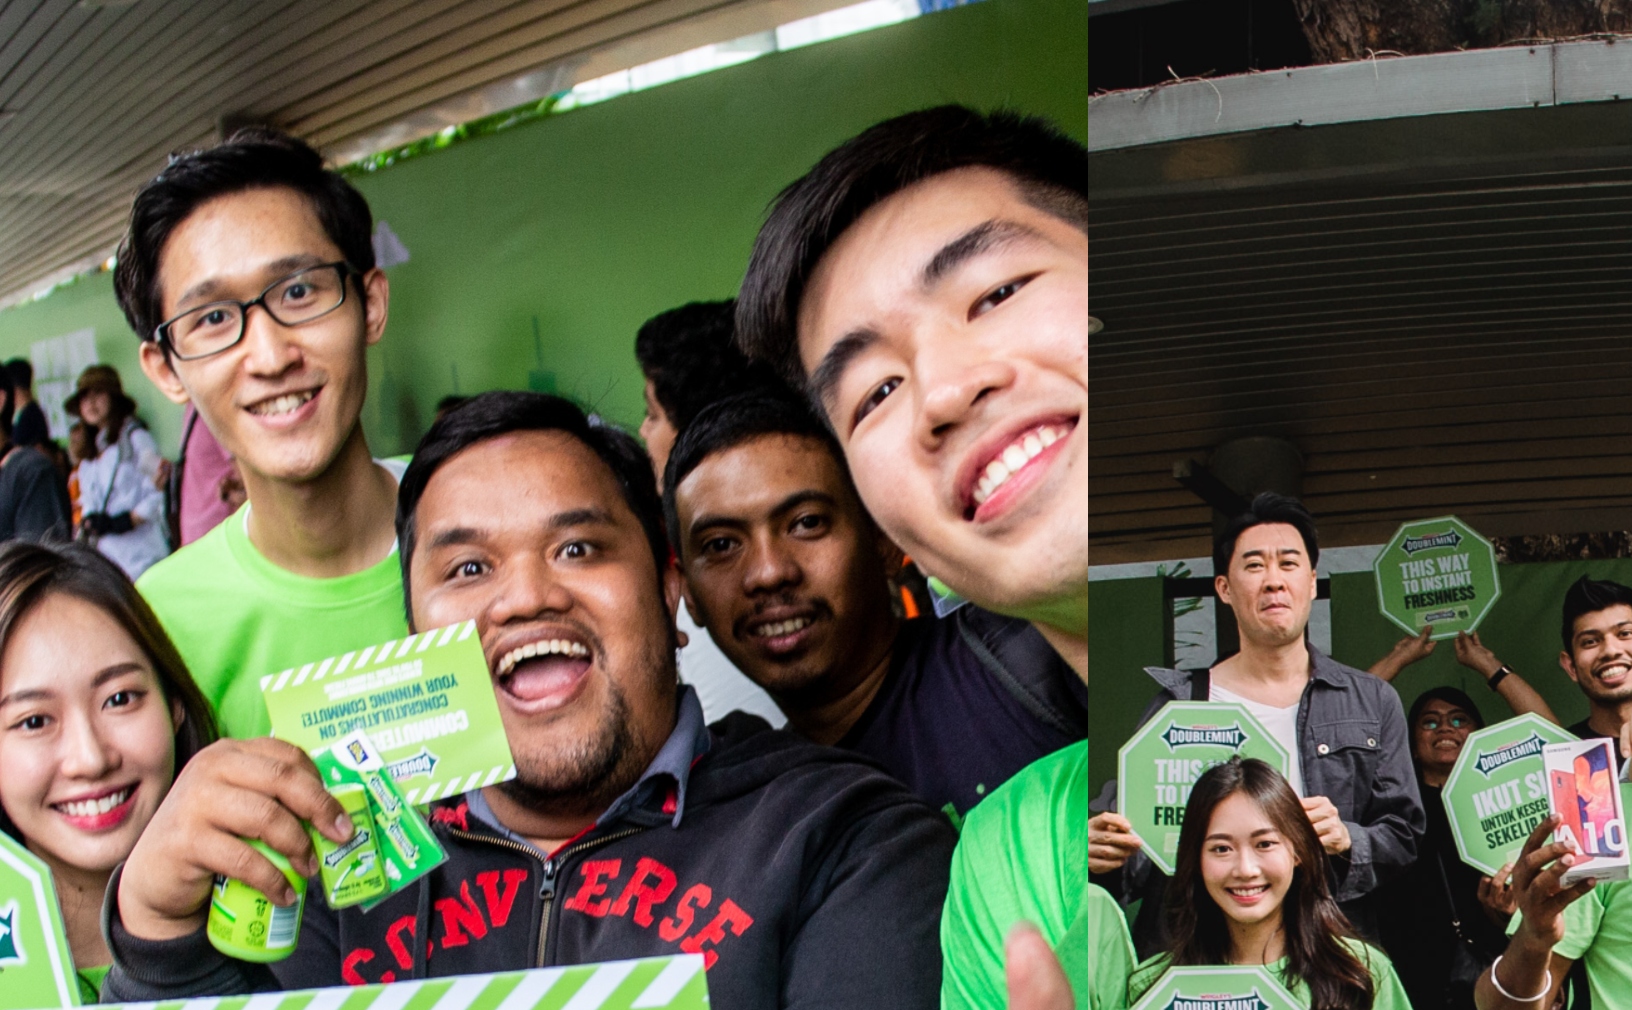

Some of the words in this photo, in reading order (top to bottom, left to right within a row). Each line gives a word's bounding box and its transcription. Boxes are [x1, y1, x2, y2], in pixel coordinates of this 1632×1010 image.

[1406, 534, 1457, 552] DOUBLEMINT
[1399, 558, 1436, 580] THIS
[1436, 553, 1470, 574] WAY
[1402, 579, 1420, 595] TO
[1421, 570, 1472, 592] INSTANT
[1404, 585, 1476, 610] FRESHNESS
[425, 672, 459, 692] YOUR
[369, 682, 424, 709] WINNING
[302, 697, 366, 729] COMMUTE!
[318, 724, 337, 741] ON
[1169, 729, 1240, 744] DOUBLEMINT
[1480, 737, 1541, 772] DOUBLEMINT
[1154, 759, 1203, 783] THIS
[1155, 785, 1177, 804] TO
[1472, 778, 1524, 819] IKUT
[1524, 769, 1549, 799] SI
[1154, 806, 1184, 826] FRE
[1481, 811, 1518, 832] UNTUK
[1517, 798, 1550, 821] KESEG
